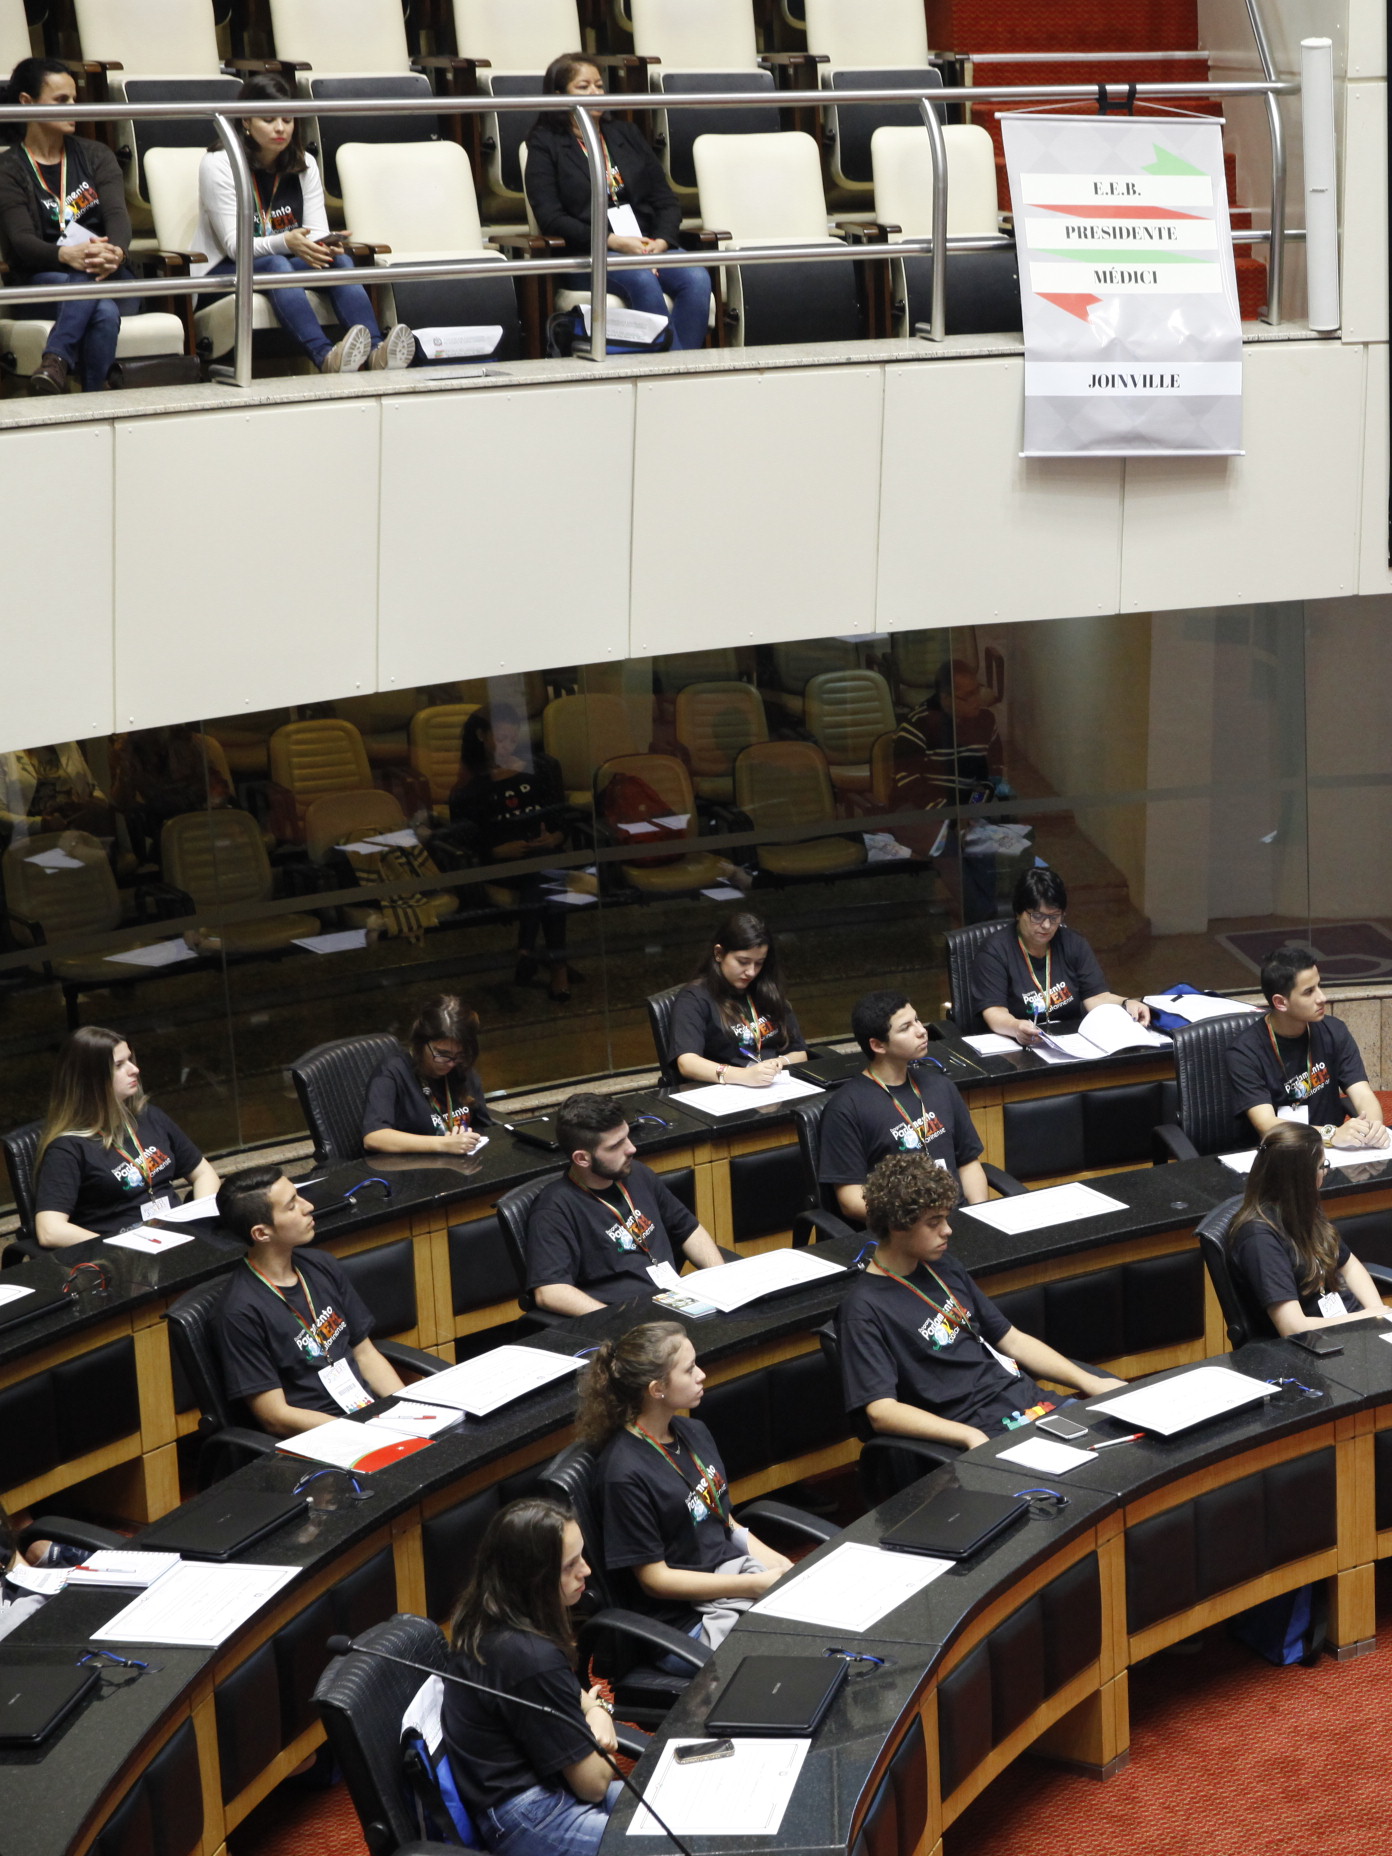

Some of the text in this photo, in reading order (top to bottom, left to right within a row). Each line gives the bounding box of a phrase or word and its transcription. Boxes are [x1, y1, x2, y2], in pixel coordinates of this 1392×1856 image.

[1093, 182, 1142, 197] E.E.B.
[1065, 226, 1178, 241] PRESIDENTE
[1093, 267, 1158, 285] MÉDICI
[1089, 374, 1180, 389] JOINVILLE
